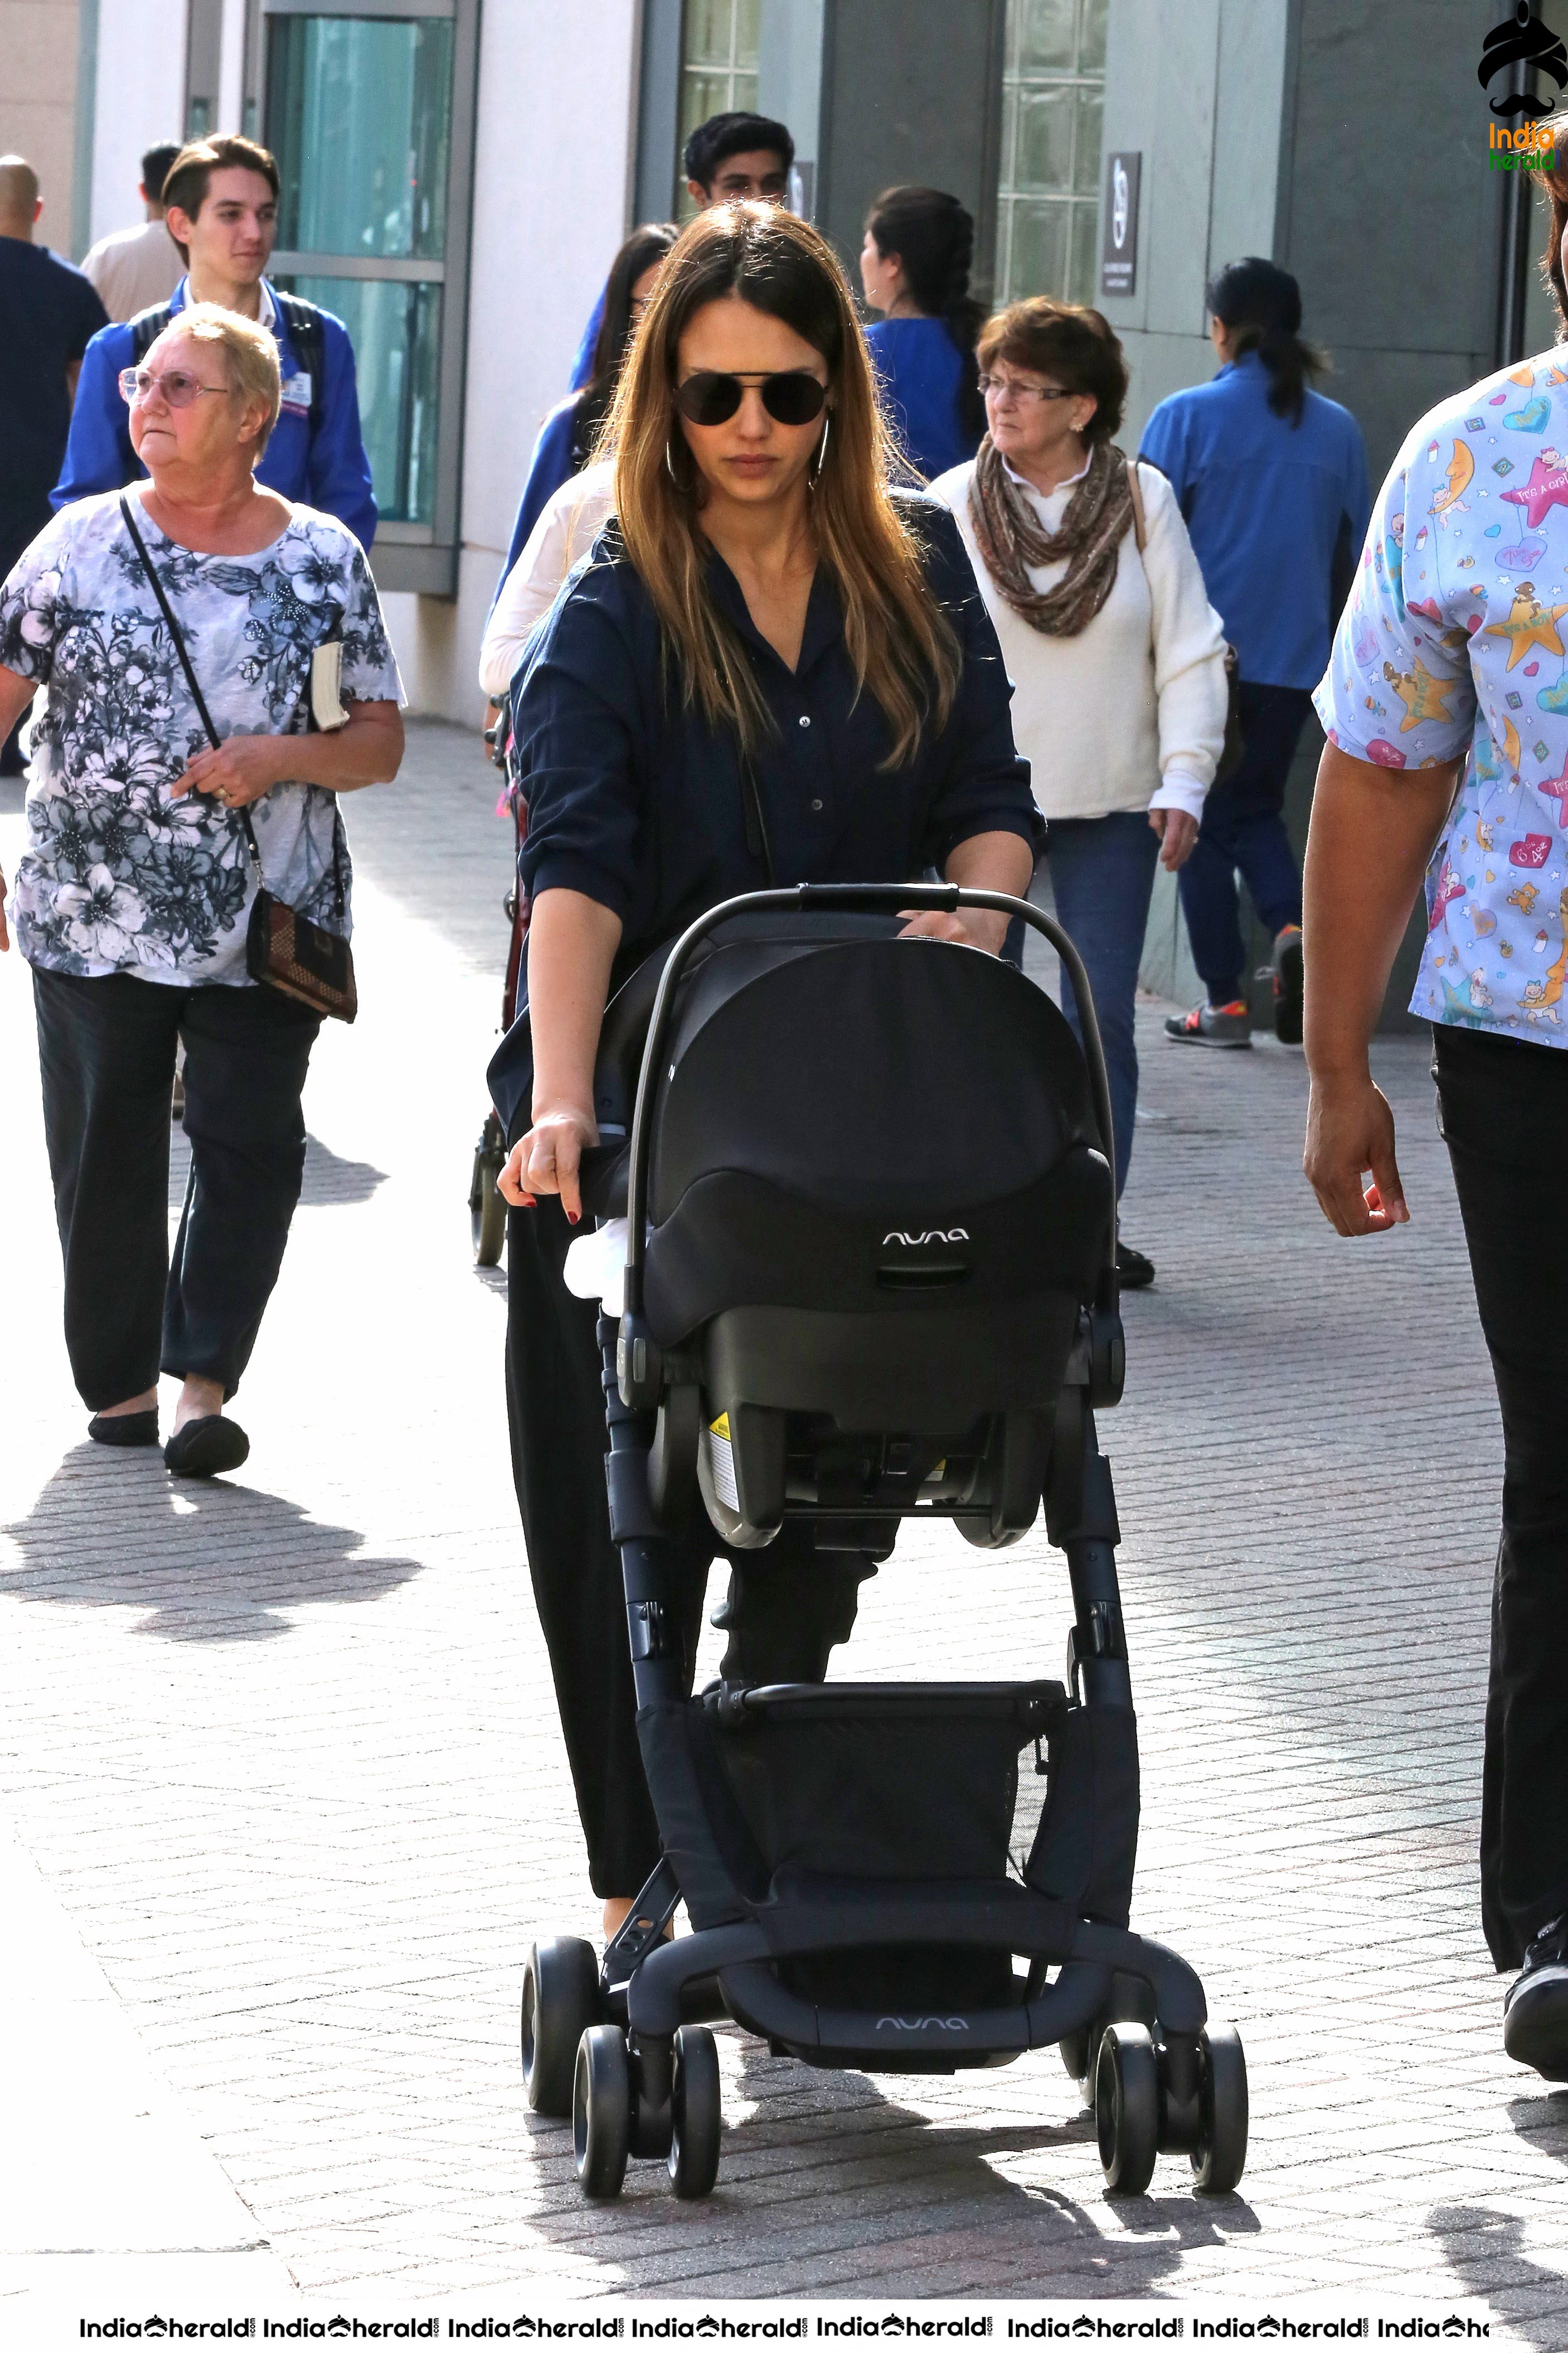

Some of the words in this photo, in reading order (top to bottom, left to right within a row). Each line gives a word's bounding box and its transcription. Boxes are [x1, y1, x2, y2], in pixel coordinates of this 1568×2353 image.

[1541, 485, 1547, 495] A
[882, 1228, 969, 1246] nuna
[875, 2017, 969, 2030] nuna
